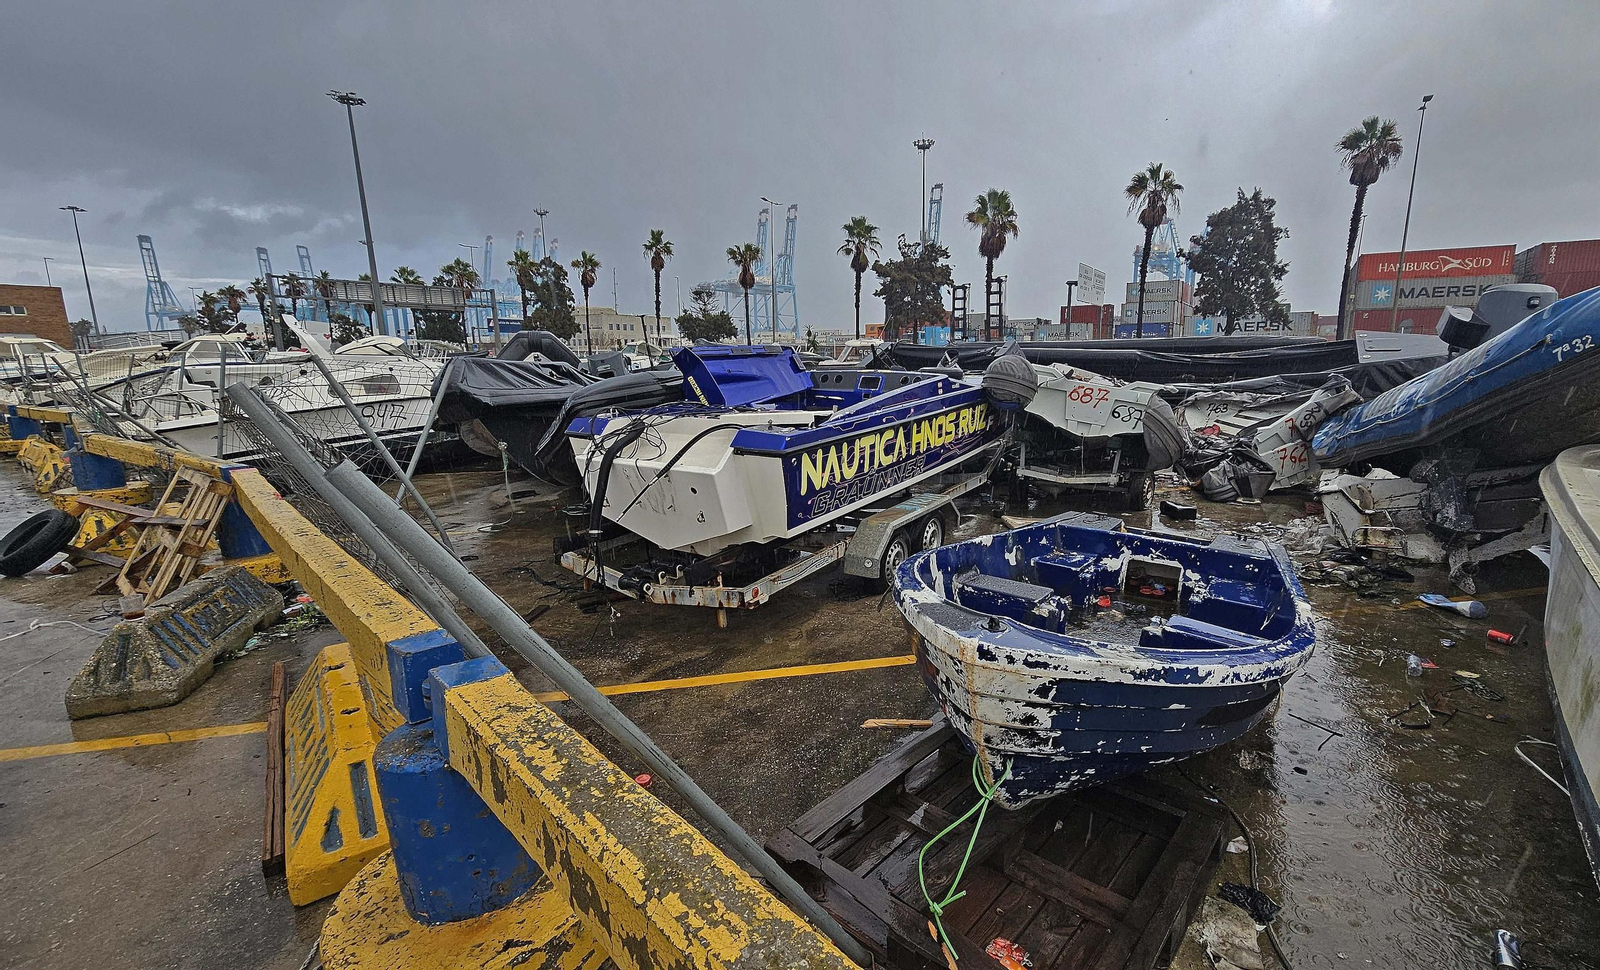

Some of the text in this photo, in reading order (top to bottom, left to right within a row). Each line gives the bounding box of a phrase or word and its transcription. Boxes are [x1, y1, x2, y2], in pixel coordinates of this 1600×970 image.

[1378, 261, 1440, 273] HAMBURG
[1464, 257, 1492, 270] SÜD
[1398, 283, 1493, 299] MAERSK
[1068, 385, 1111, 409] 687
[361, 403, 407, 430] 947
[1112, 404, 1143, 430] 687
[1206, 402, 1229, 419] 763
[800, 403, 989, 497] NAUTICA HNOS RUIZ
[1277, 442, 1309, 471] 762
